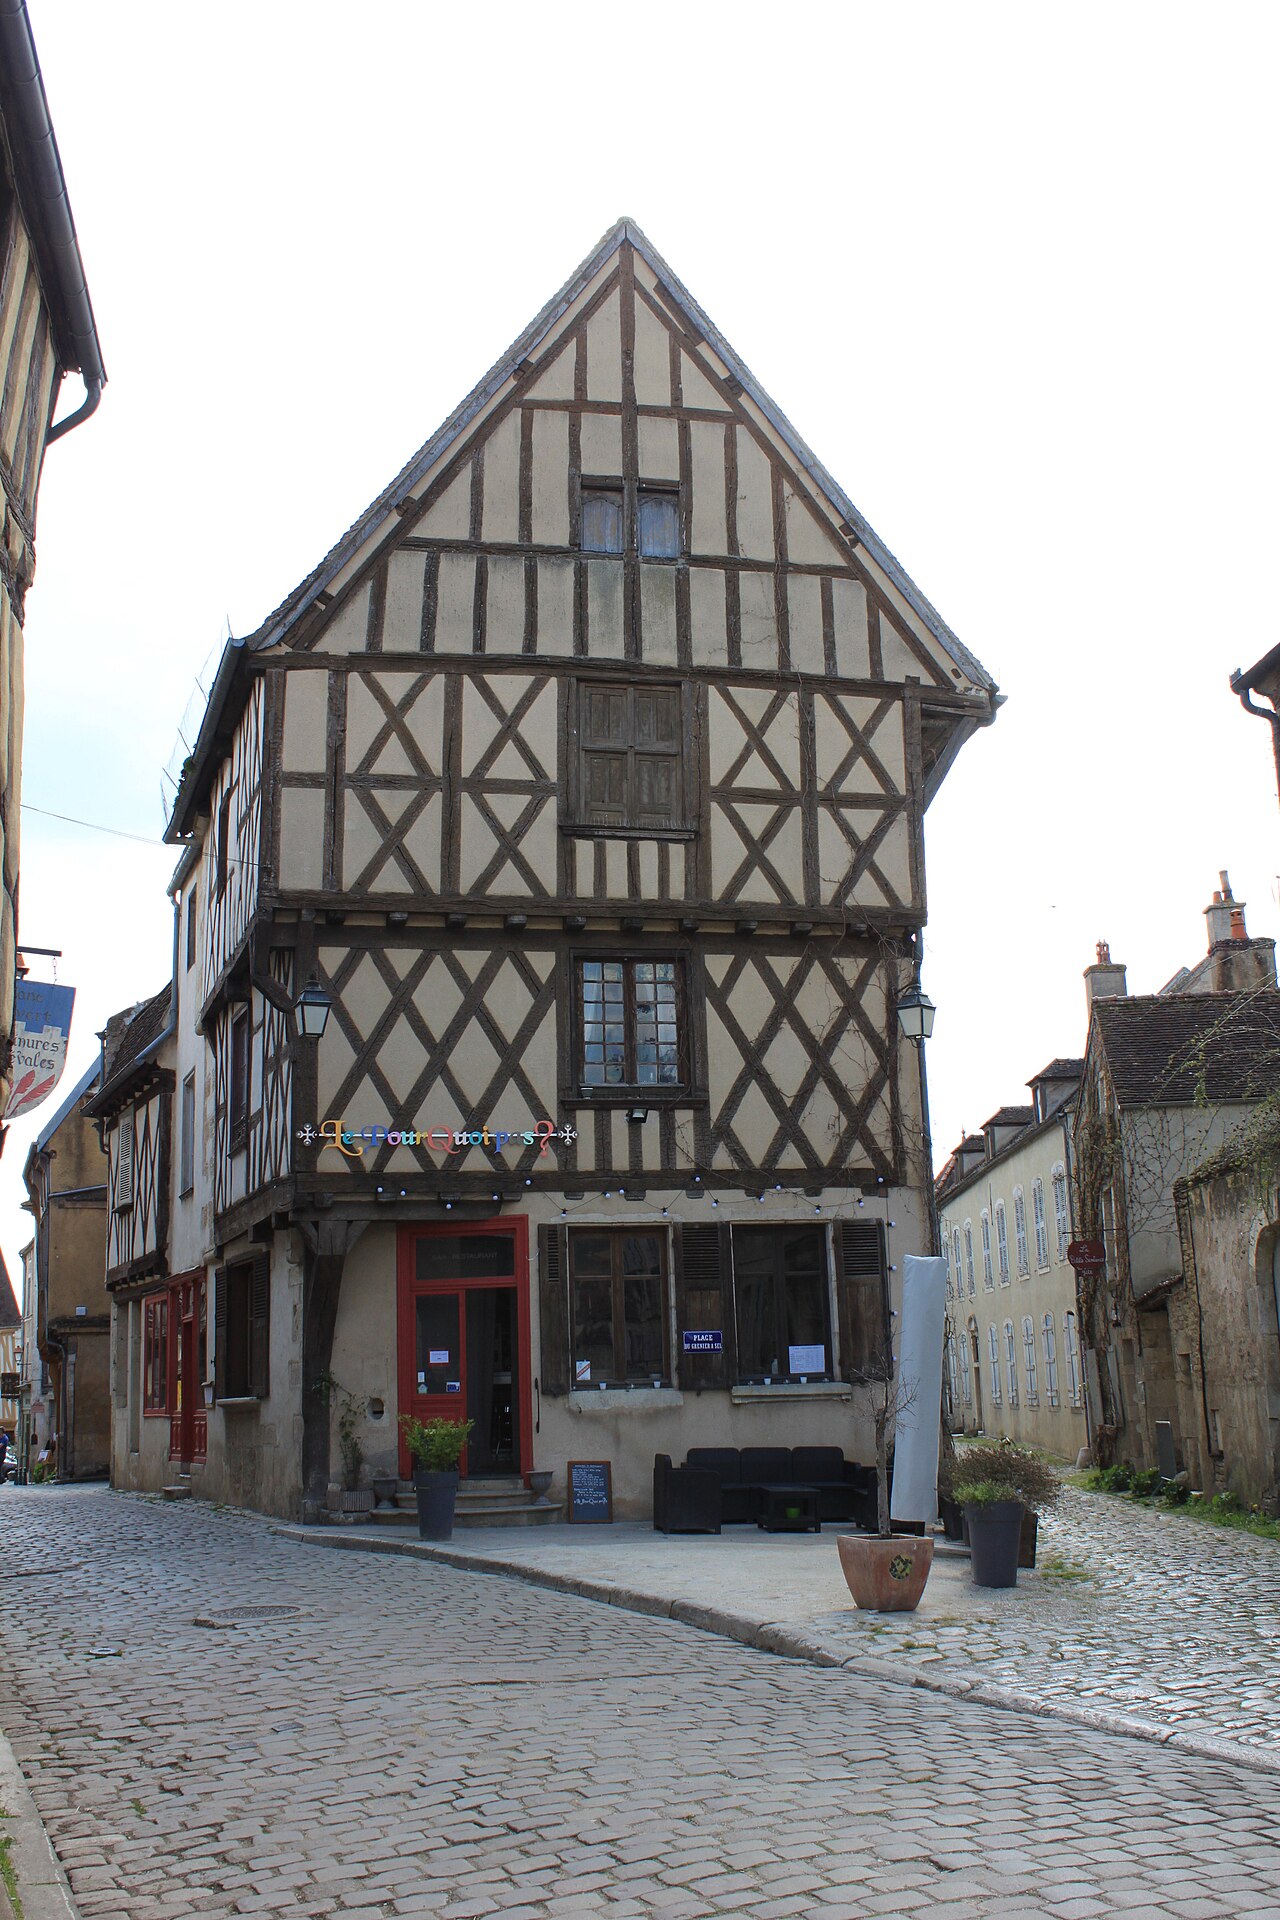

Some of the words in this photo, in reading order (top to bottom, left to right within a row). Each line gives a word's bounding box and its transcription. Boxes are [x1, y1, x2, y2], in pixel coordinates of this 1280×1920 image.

[320, 1120, 363, 1156] Le
[494, 1120, 555, 1158] pas?
[693, 1334, 713, 1342] PLACE
